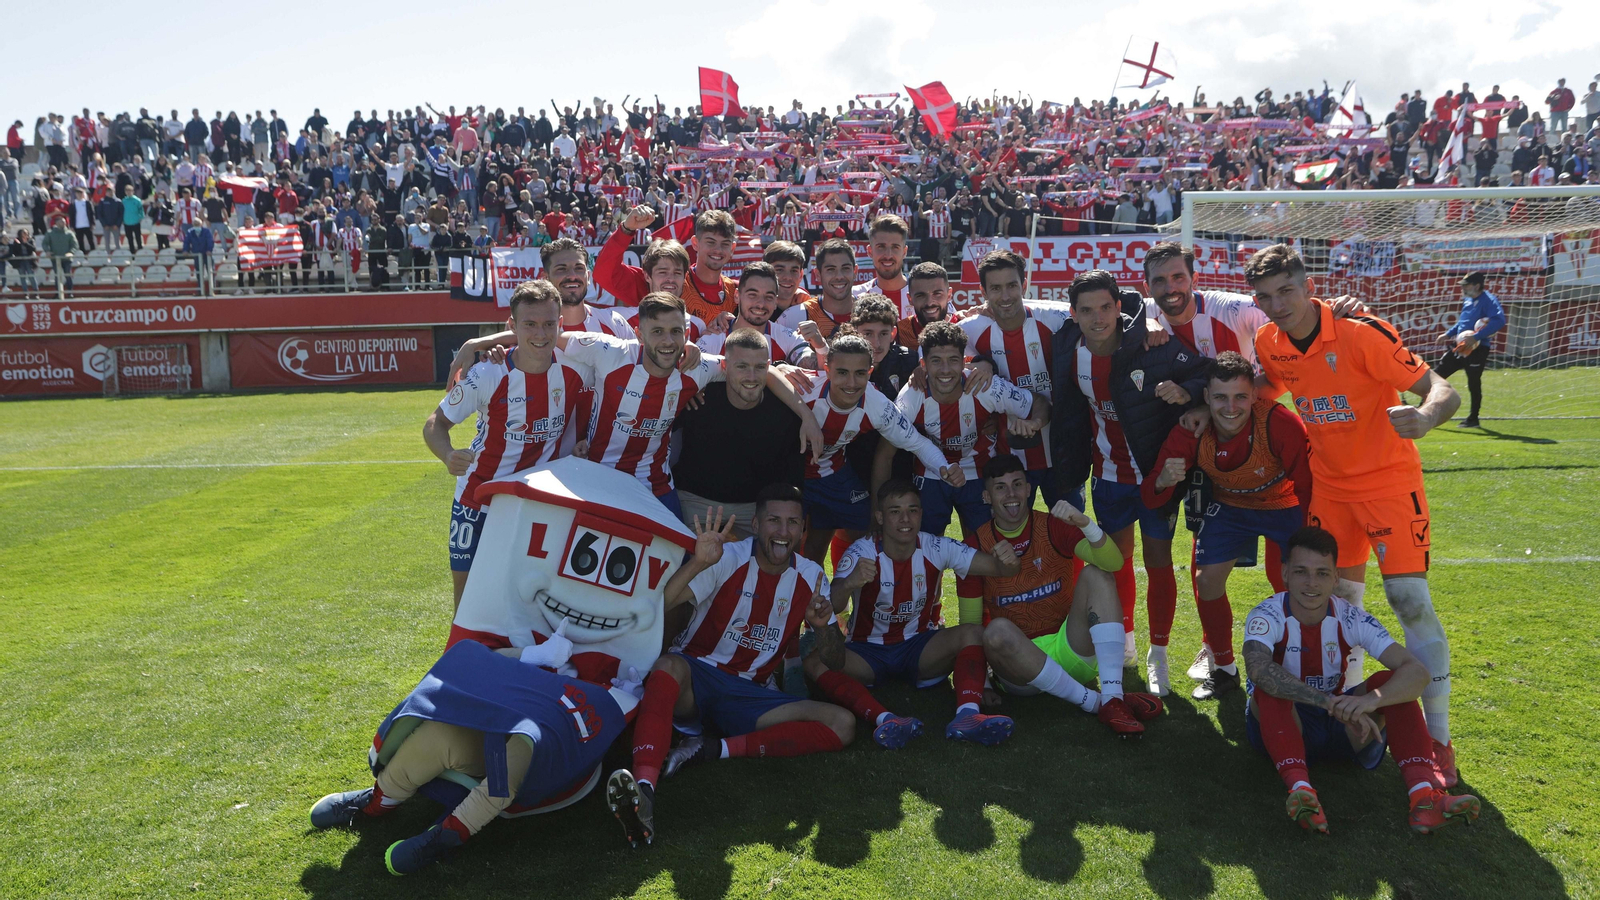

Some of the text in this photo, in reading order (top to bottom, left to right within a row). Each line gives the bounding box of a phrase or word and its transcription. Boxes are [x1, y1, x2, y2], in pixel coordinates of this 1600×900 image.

[31, 304, 50, 312] 956
[33, 312, 51, 321] 573
[59, 305, 168, 325] Cruzcampo
[33, 321, 51, 330] 557
[314, 337, 418, 354] CENTRO DEPORTIVO
[0, 349, 49, 365] futbol
[335, 353, 398, 373] LA VILLA
[2, 365, 74, 380] emotion
[123, 361, 192, 376] emotion
[1312, 395, 1351, 413] 威视
[532, 414, 565, 433] 威视
[504, 429, 564, 444] NUCTECH
[449, 520, 474, 549] 20
[527, 522, 548, 559] L
[648, 556, 670, 590] Y
[1001, 580, 1061, 605] STOP-FLUID
[723, 630, 777, 652] NUCTECH
[750, 624, 780, 642] 威视
